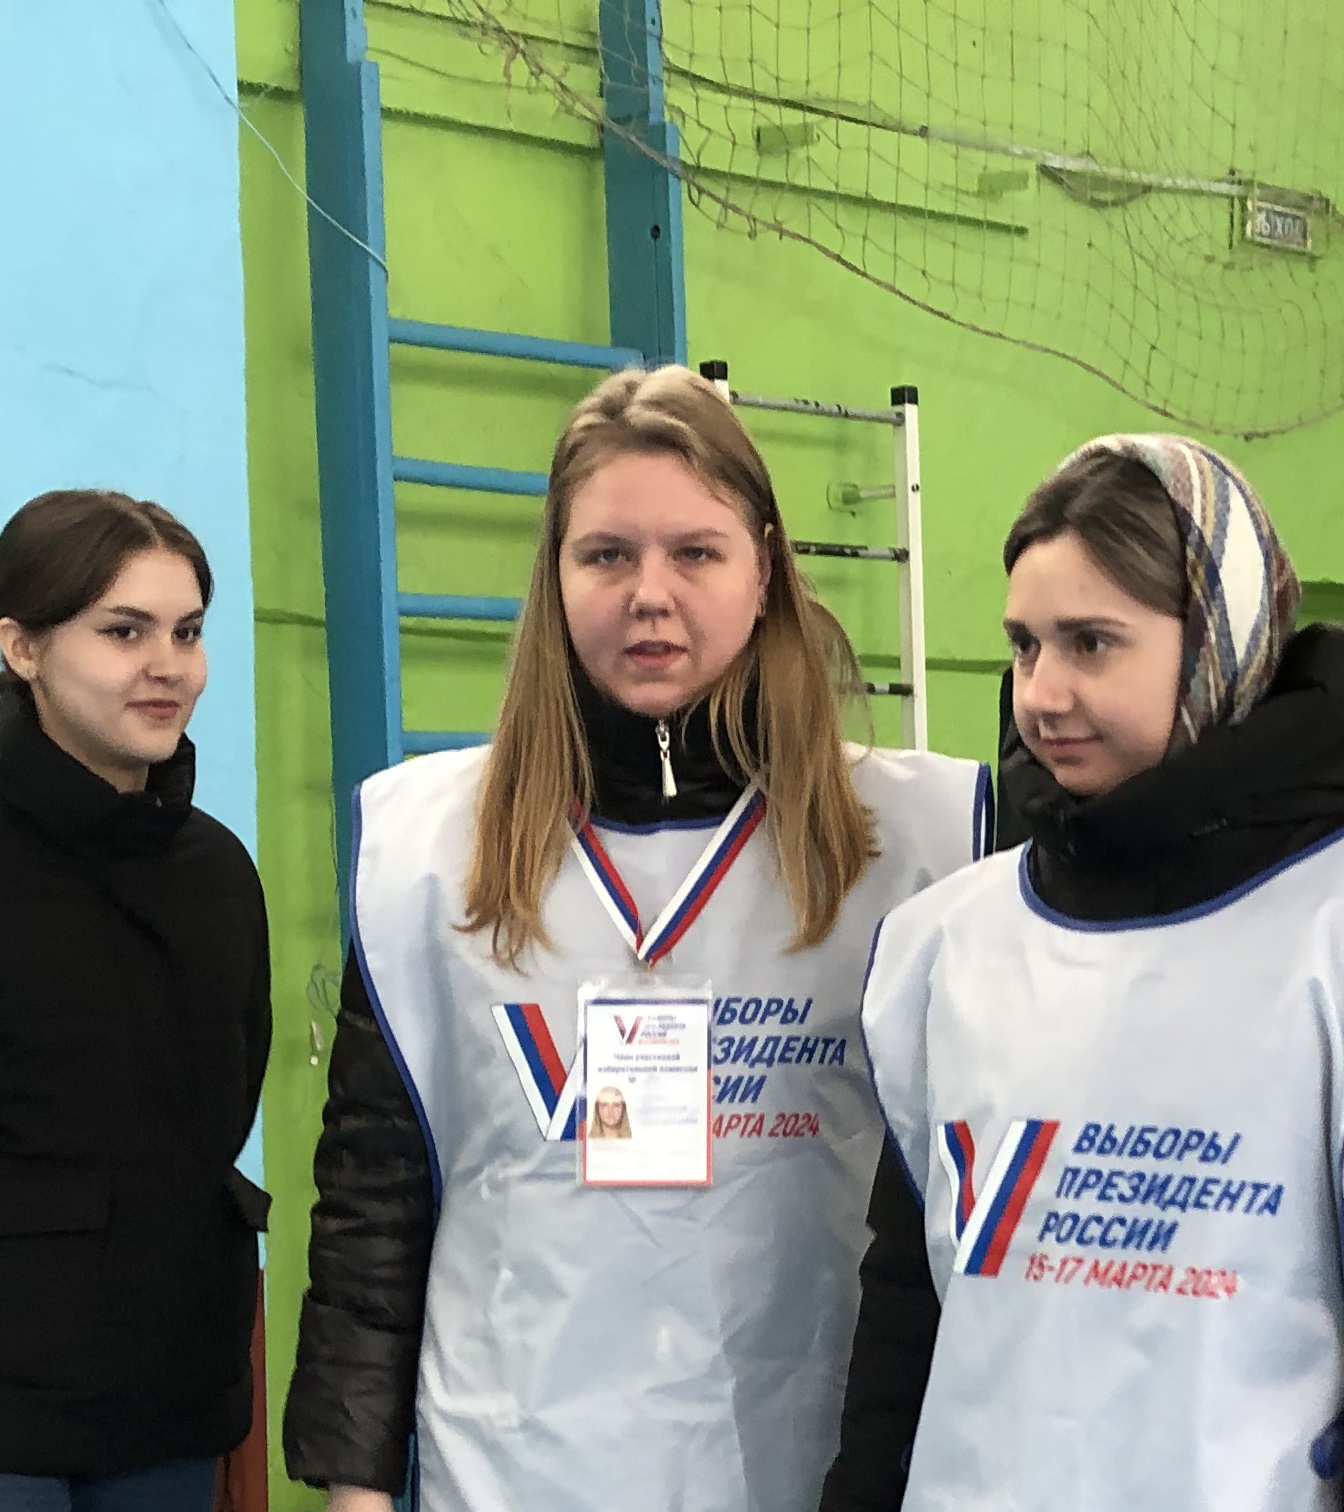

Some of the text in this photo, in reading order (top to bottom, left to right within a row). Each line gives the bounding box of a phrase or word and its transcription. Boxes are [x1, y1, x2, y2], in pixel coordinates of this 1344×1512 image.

[712, 996, 814, 1026] БОРЫ
[712, 1035, 847, 1069] ЗИДЕНТА
[712, 1112, 765, 1139] АРТА
[767, 1111, 820, 1138] 2024
[1072, 1121, 1243, 1167] ВЫБОРЫ
[1055, 1165, 1286, 1217] ПРЕЗИДЕНТА
[1038, 1210, 1180, 1254] РОССИИ
[1083, 1258, 1174, 1293] МАРТА
